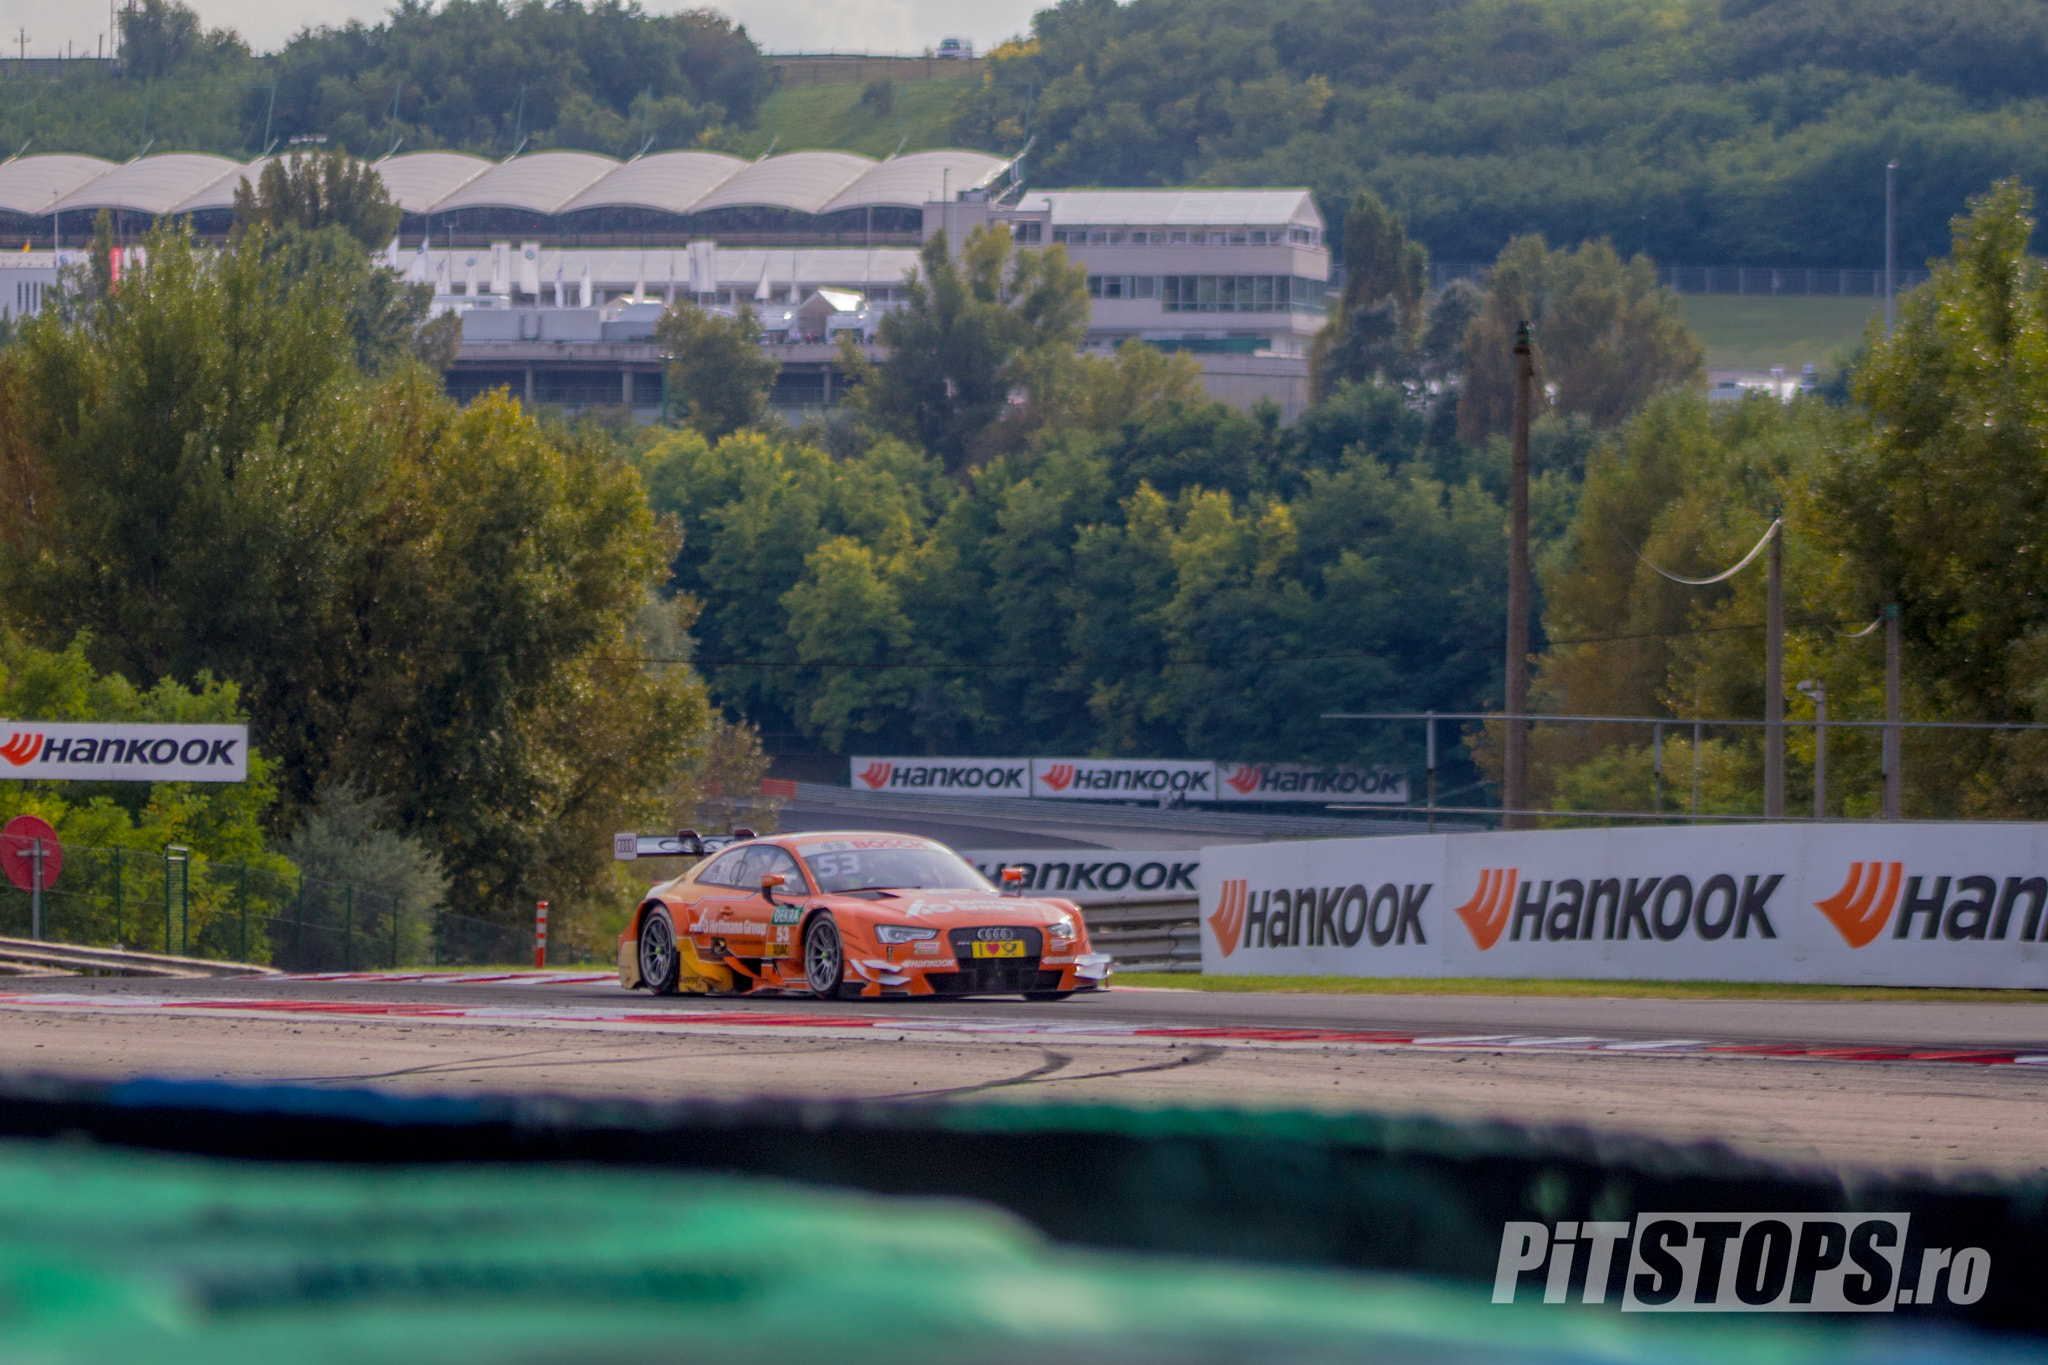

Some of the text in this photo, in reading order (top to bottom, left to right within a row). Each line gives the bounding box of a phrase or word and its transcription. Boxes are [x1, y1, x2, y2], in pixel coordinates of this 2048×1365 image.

[40, 738, 239, 766] HanKOOK
[890, 766, 1025, 789] HanKOOK
[1074, 769, 1211, 791] HanKOOK
[852, 840, 928, 850] BOSCH
[817, 854, 861, 878] 53
[773, 908, 799, 923] DEKRA
[1244, 882, 1434, 949] HanKOOK
[1510, 873, 1787, 942] HanKOOK
[1896, 874, 2048, 942] Han
[709, 919, 767, 936] Hoffmann Group
[776, 926, 790, 943] 53
[773, 944, 789, 956] ADAC
